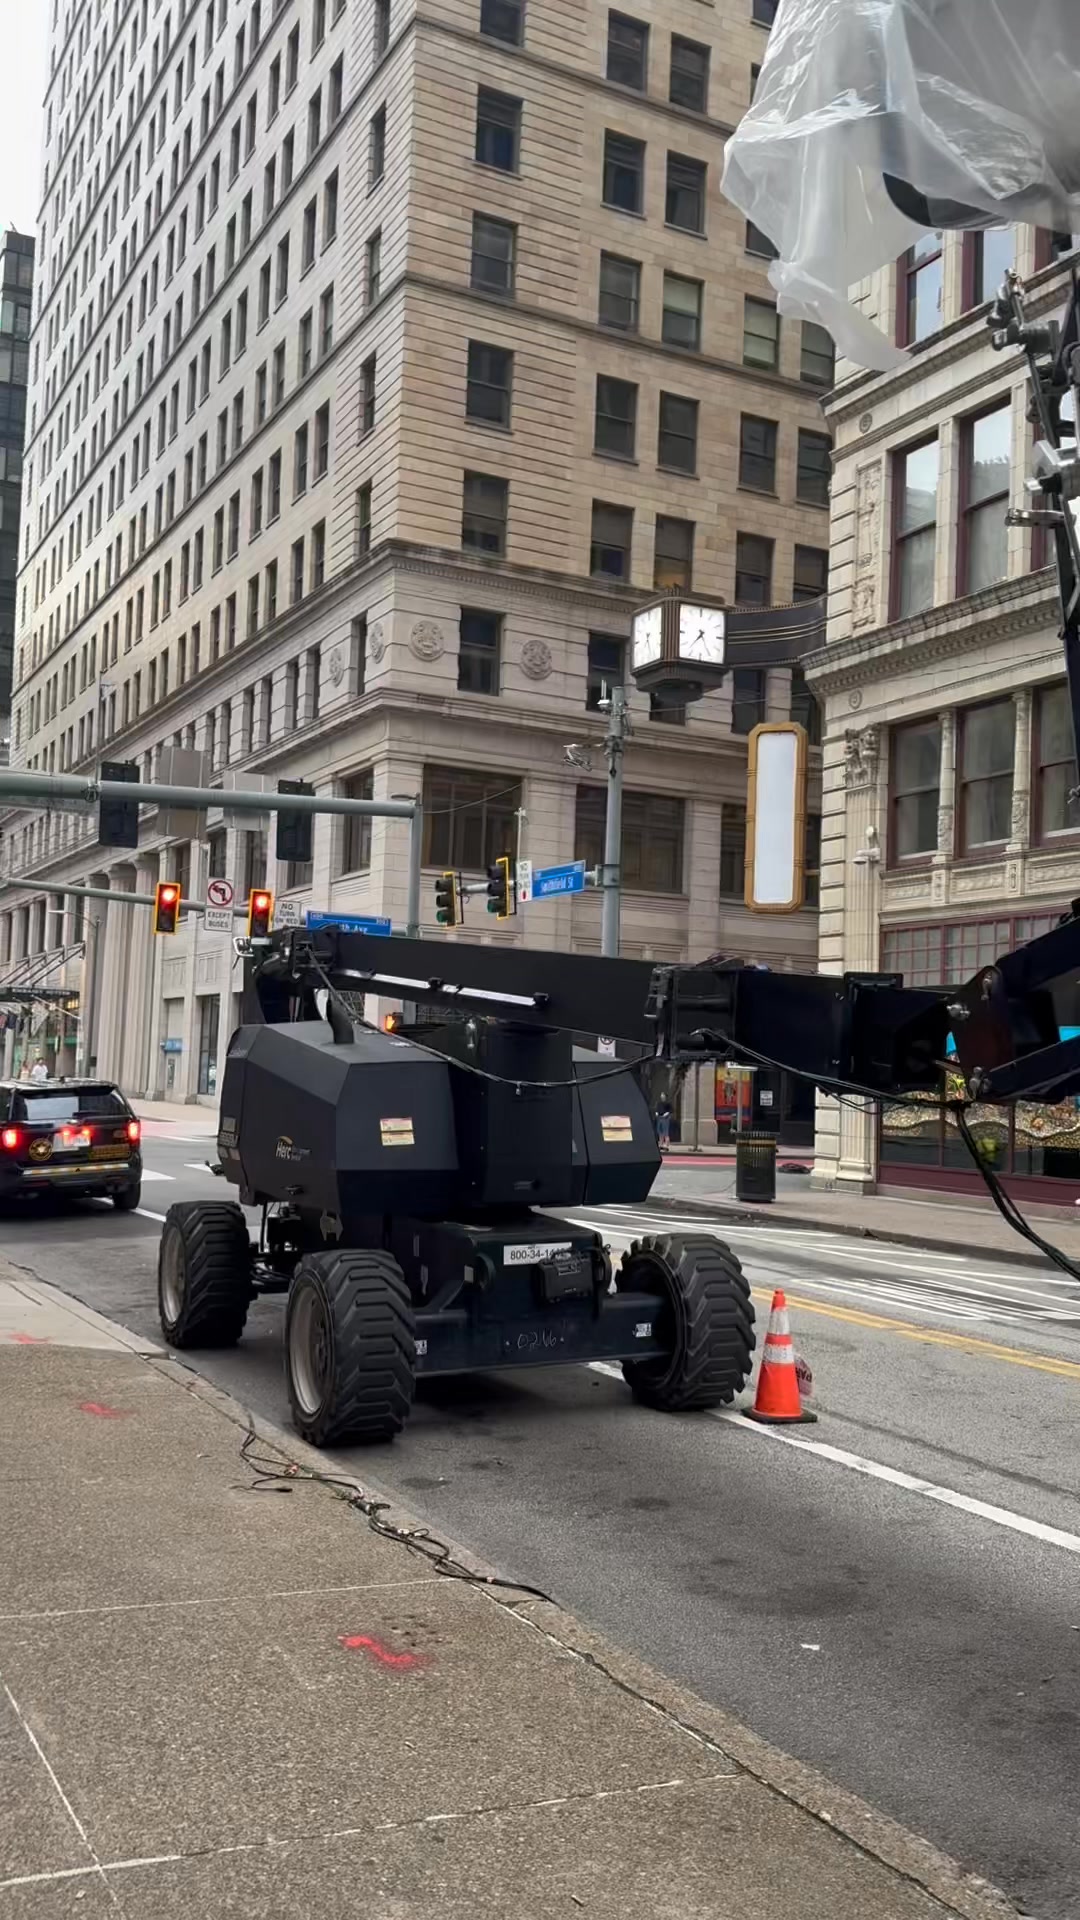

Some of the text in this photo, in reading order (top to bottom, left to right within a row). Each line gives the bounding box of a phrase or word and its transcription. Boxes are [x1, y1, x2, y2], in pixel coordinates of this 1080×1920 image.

[281, 903, 294, 911] NO
[207, 911, 231, 920] EXCEPT
[208, 921, 229, 929] BUSES
